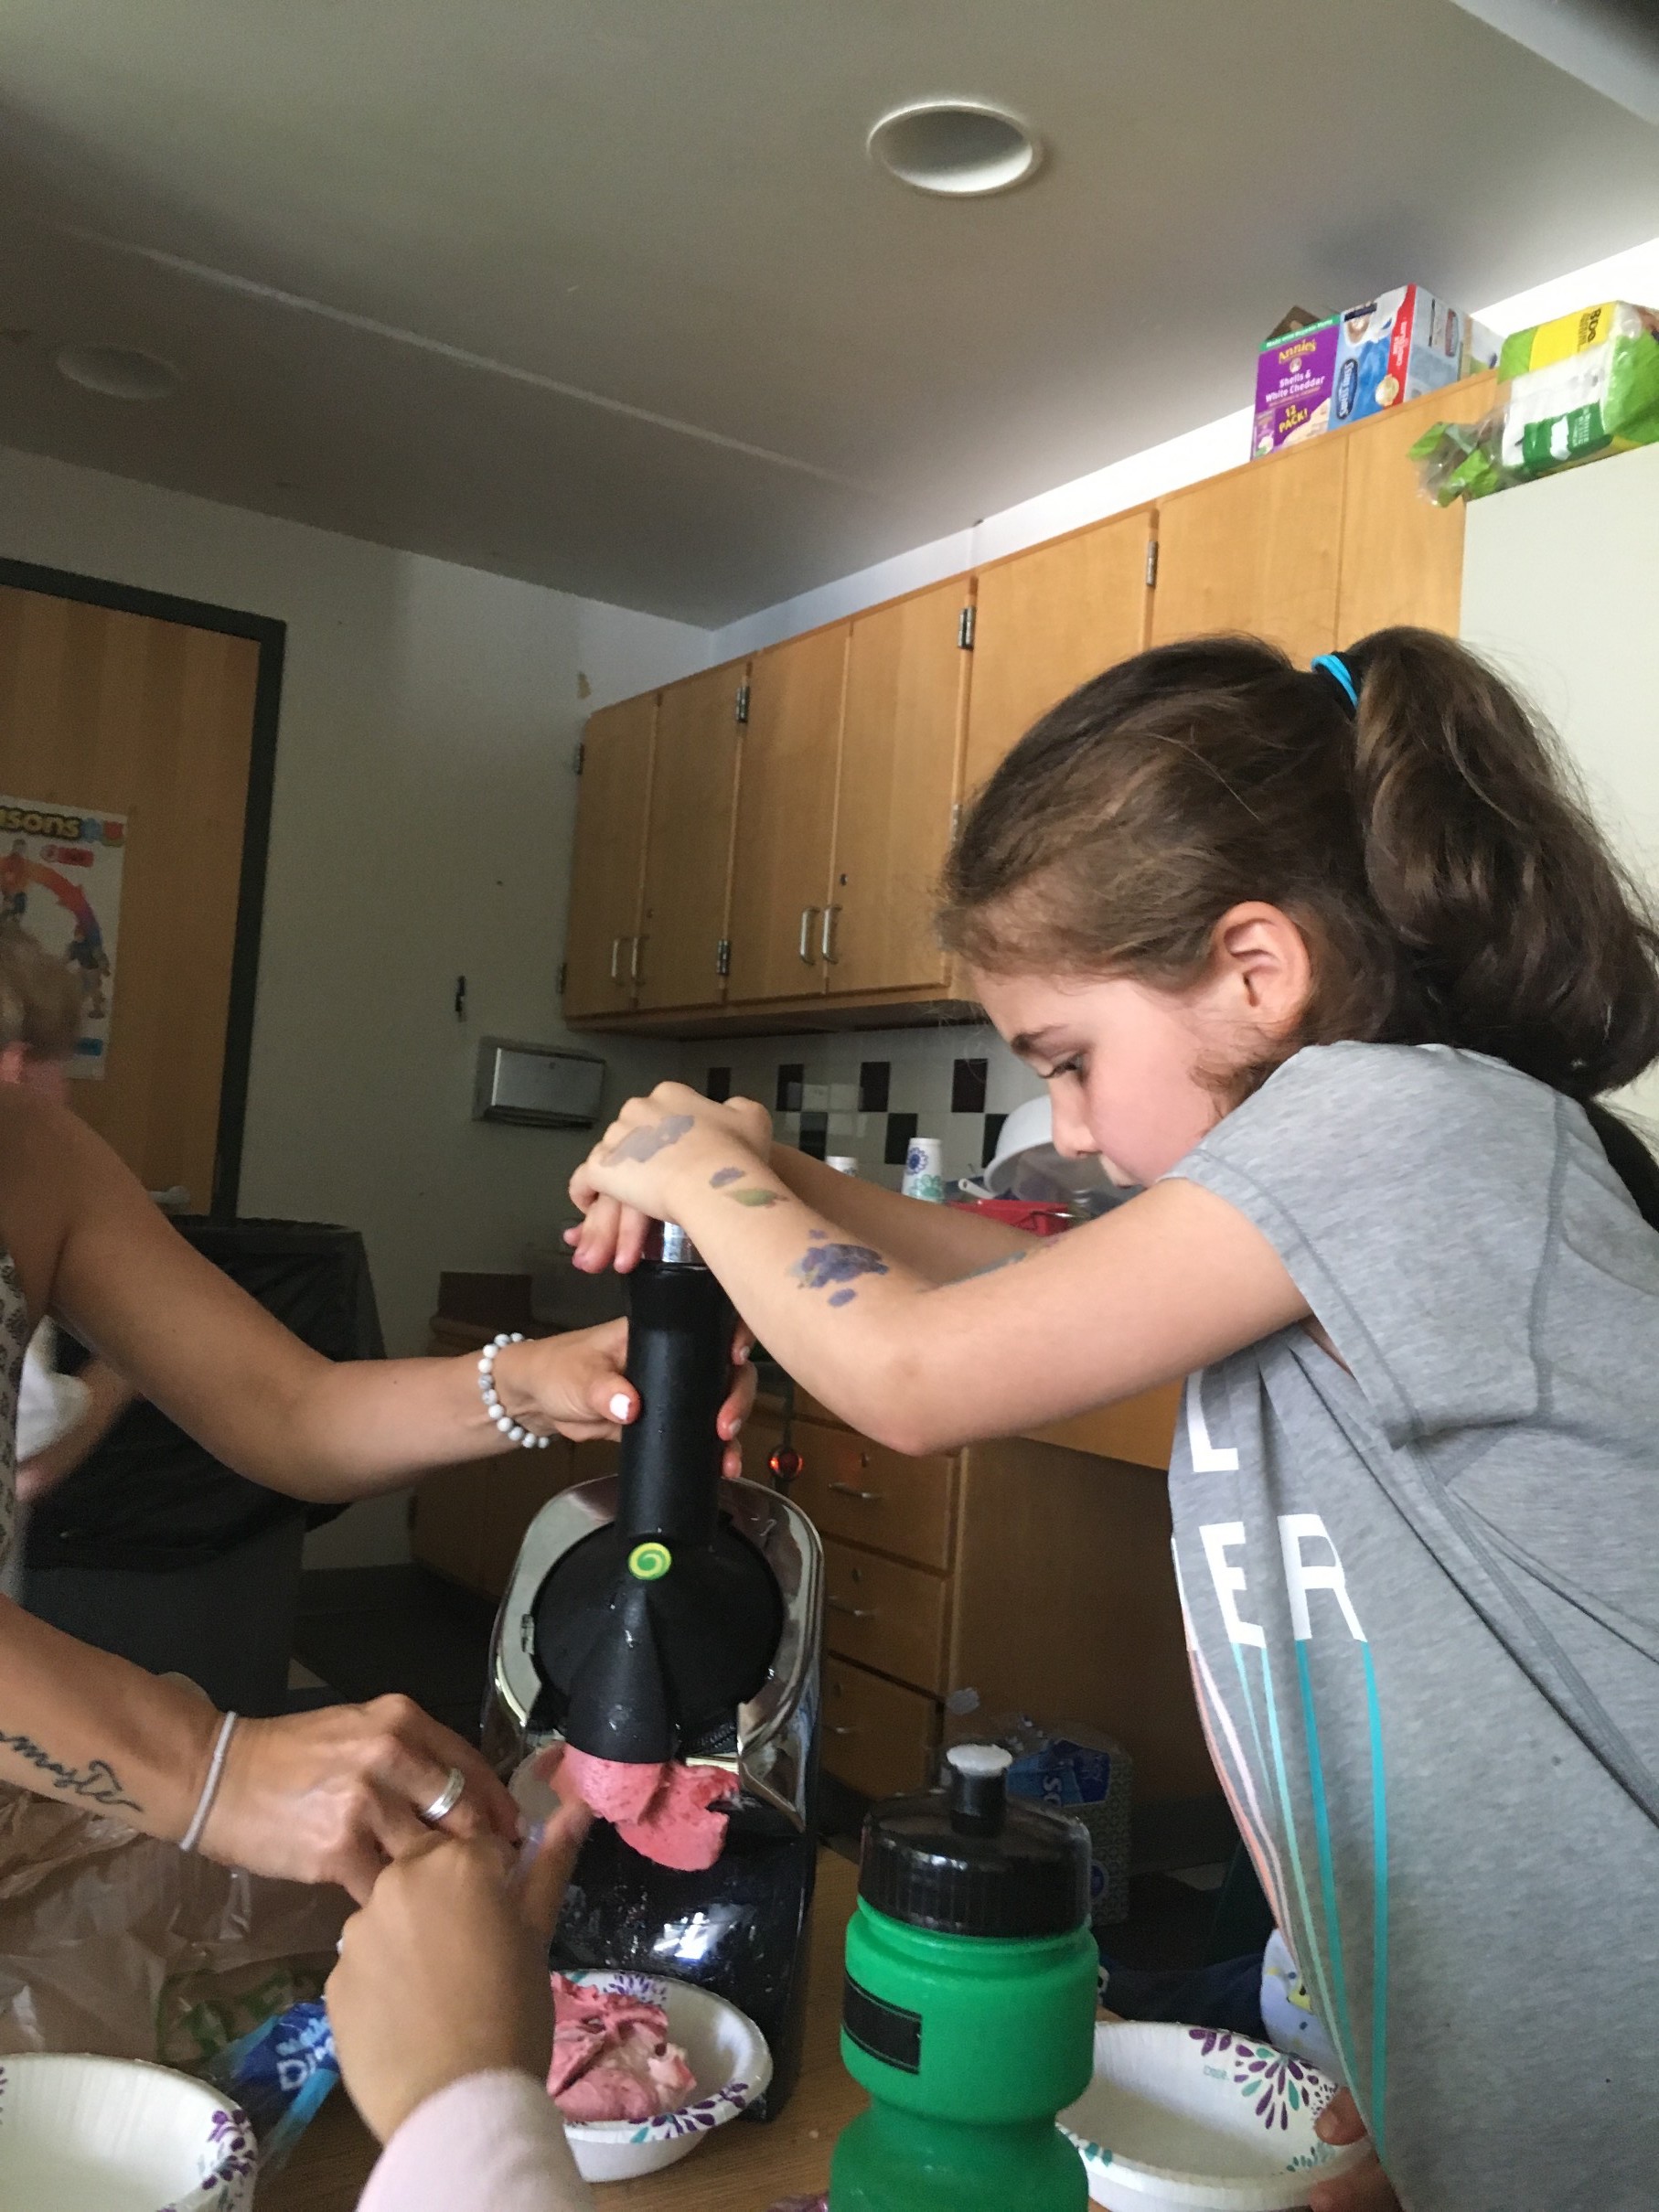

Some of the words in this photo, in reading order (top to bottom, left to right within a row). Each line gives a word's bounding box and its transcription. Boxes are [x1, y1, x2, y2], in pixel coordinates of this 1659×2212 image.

[1266, 389, 1289, 403] White
[1290, 376, 1325, 394] Cheddar
[1279, 373, 1304, 389] Shells
[1305, 369, 1311, 379] &
[1279, 408, 1308, 433] PACK!
[1285, 404, 1297, 418] 12
[0, 807, 81, 839] sons
[1172, 1513, 1368, 1651] ER
